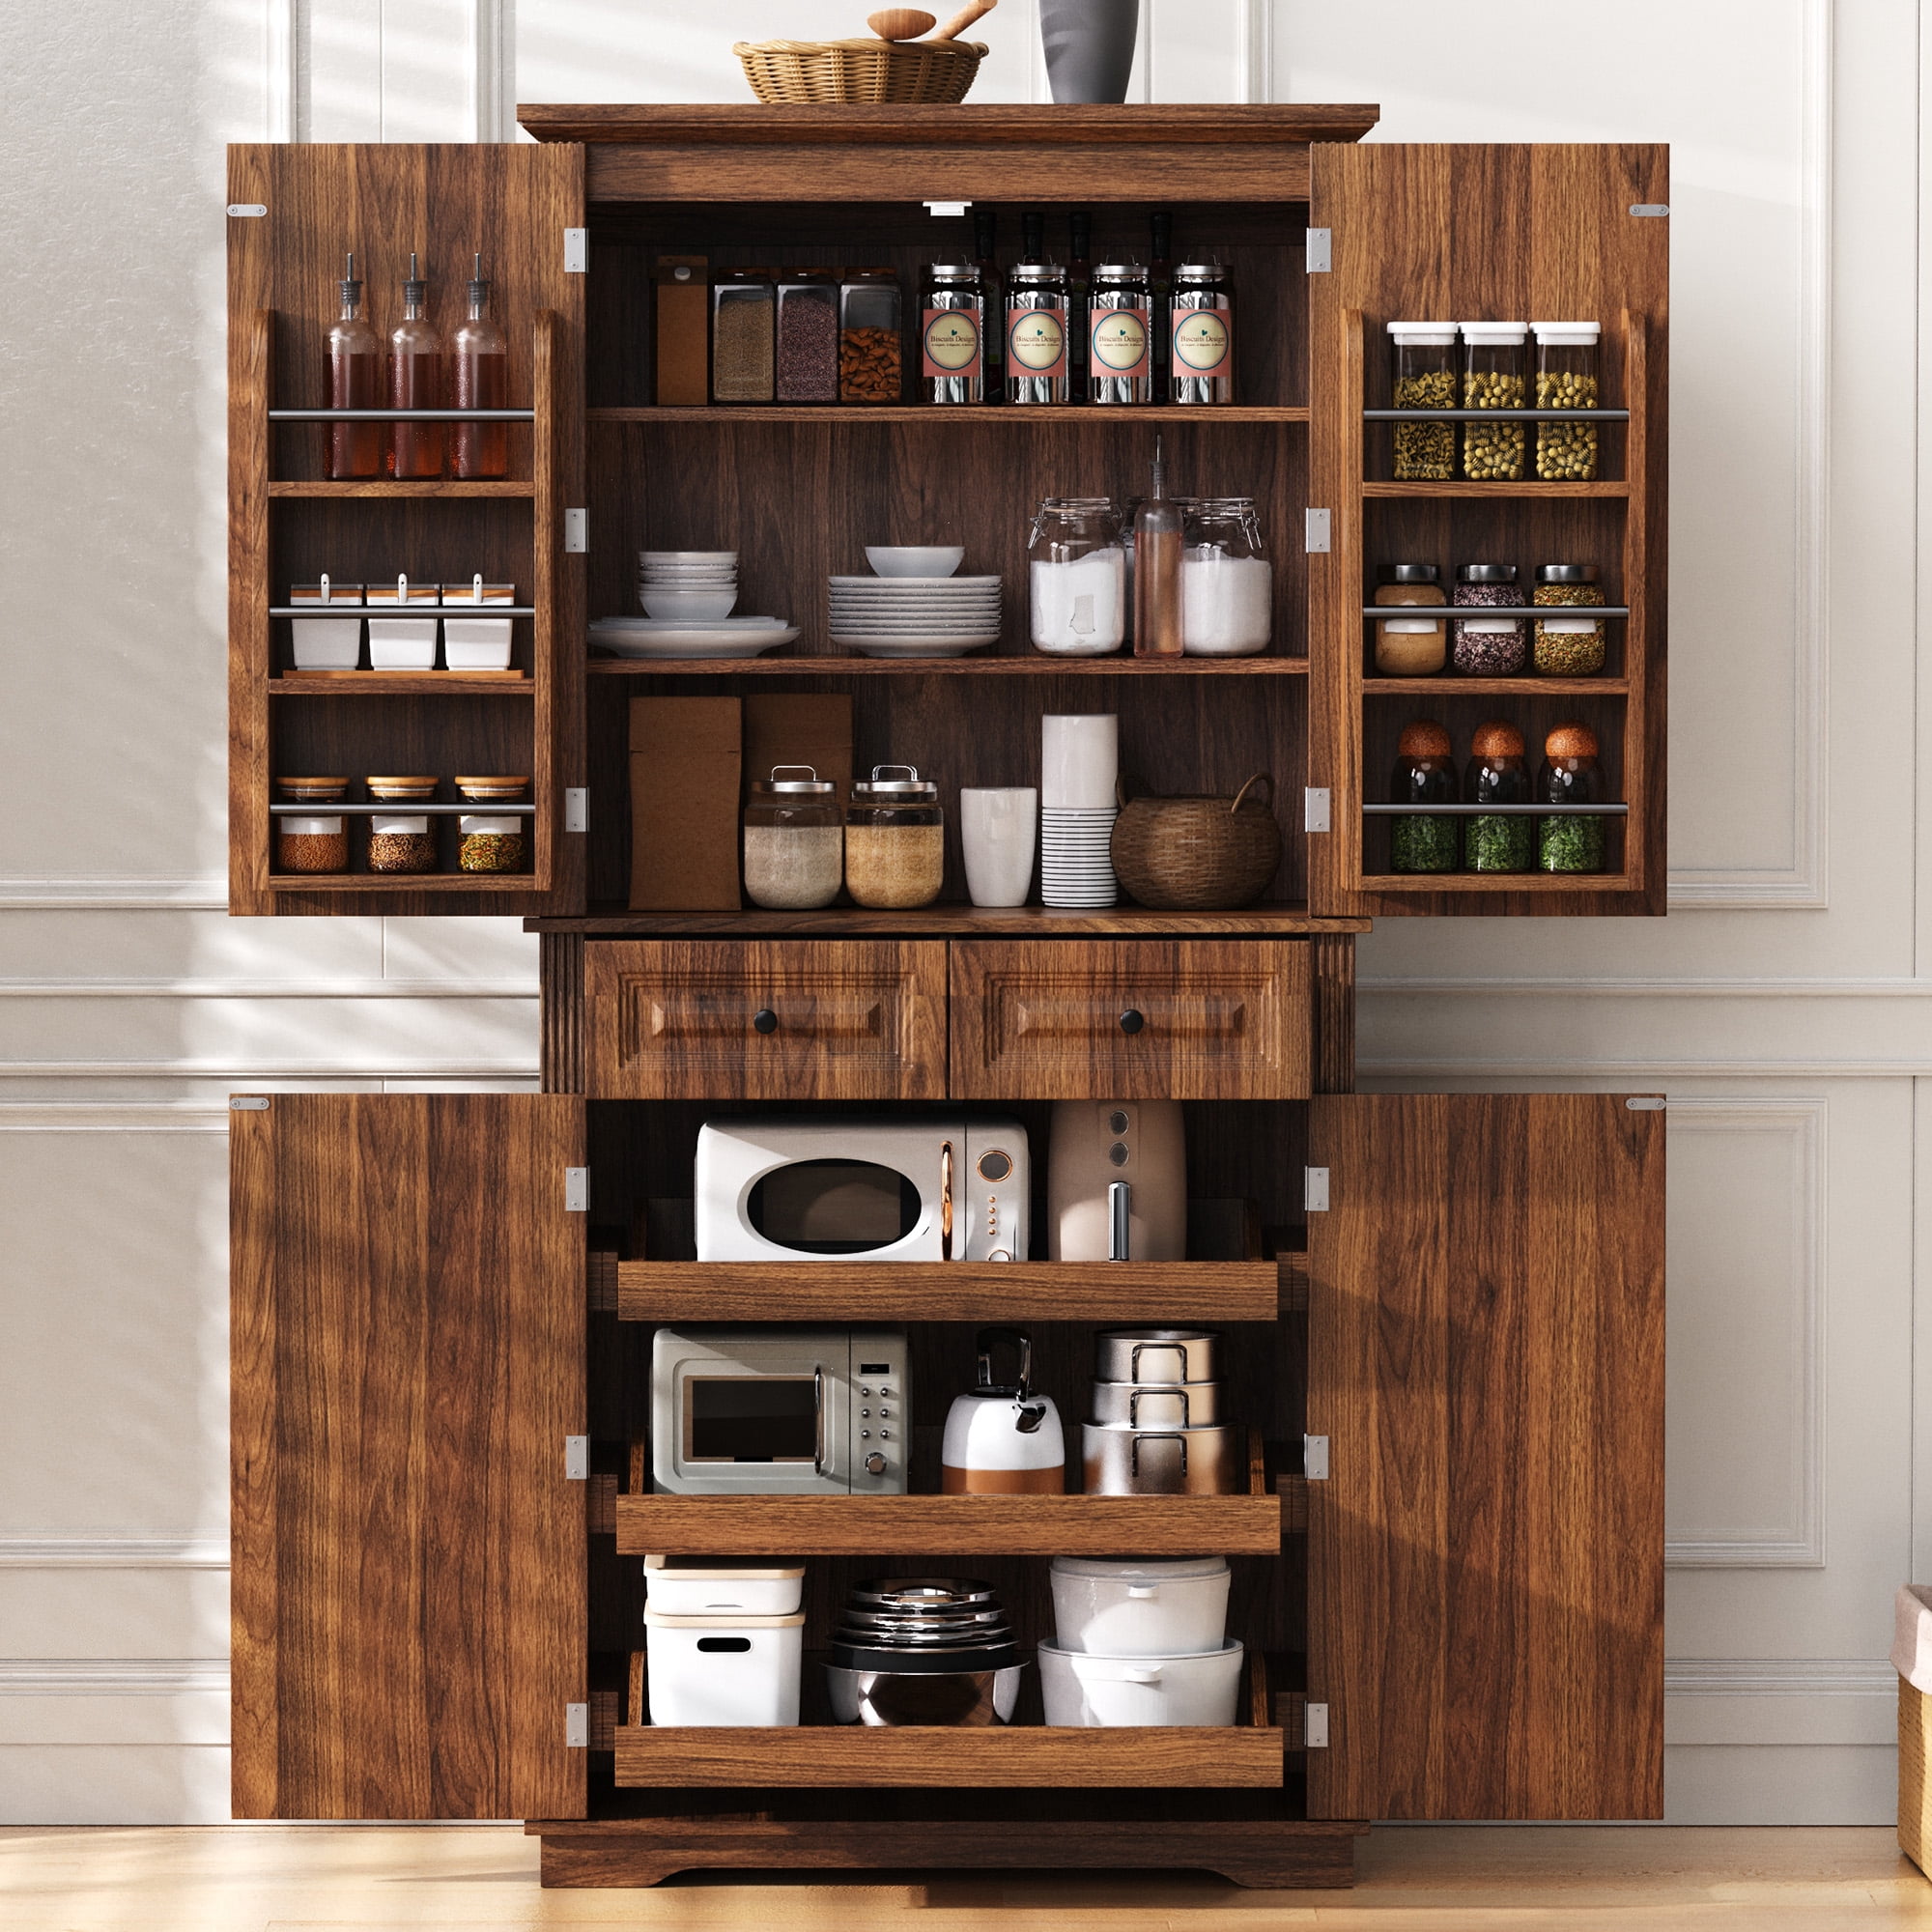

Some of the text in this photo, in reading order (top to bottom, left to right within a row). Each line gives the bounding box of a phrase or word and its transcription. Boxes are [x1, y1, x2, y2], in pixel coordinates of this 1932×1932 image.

[955, 335, 975, 344] Design
[1041, 335, 1061, 344] Design
[1123, 335, 1144, 344] Design
[1206, 335, 1225, 344] Design
